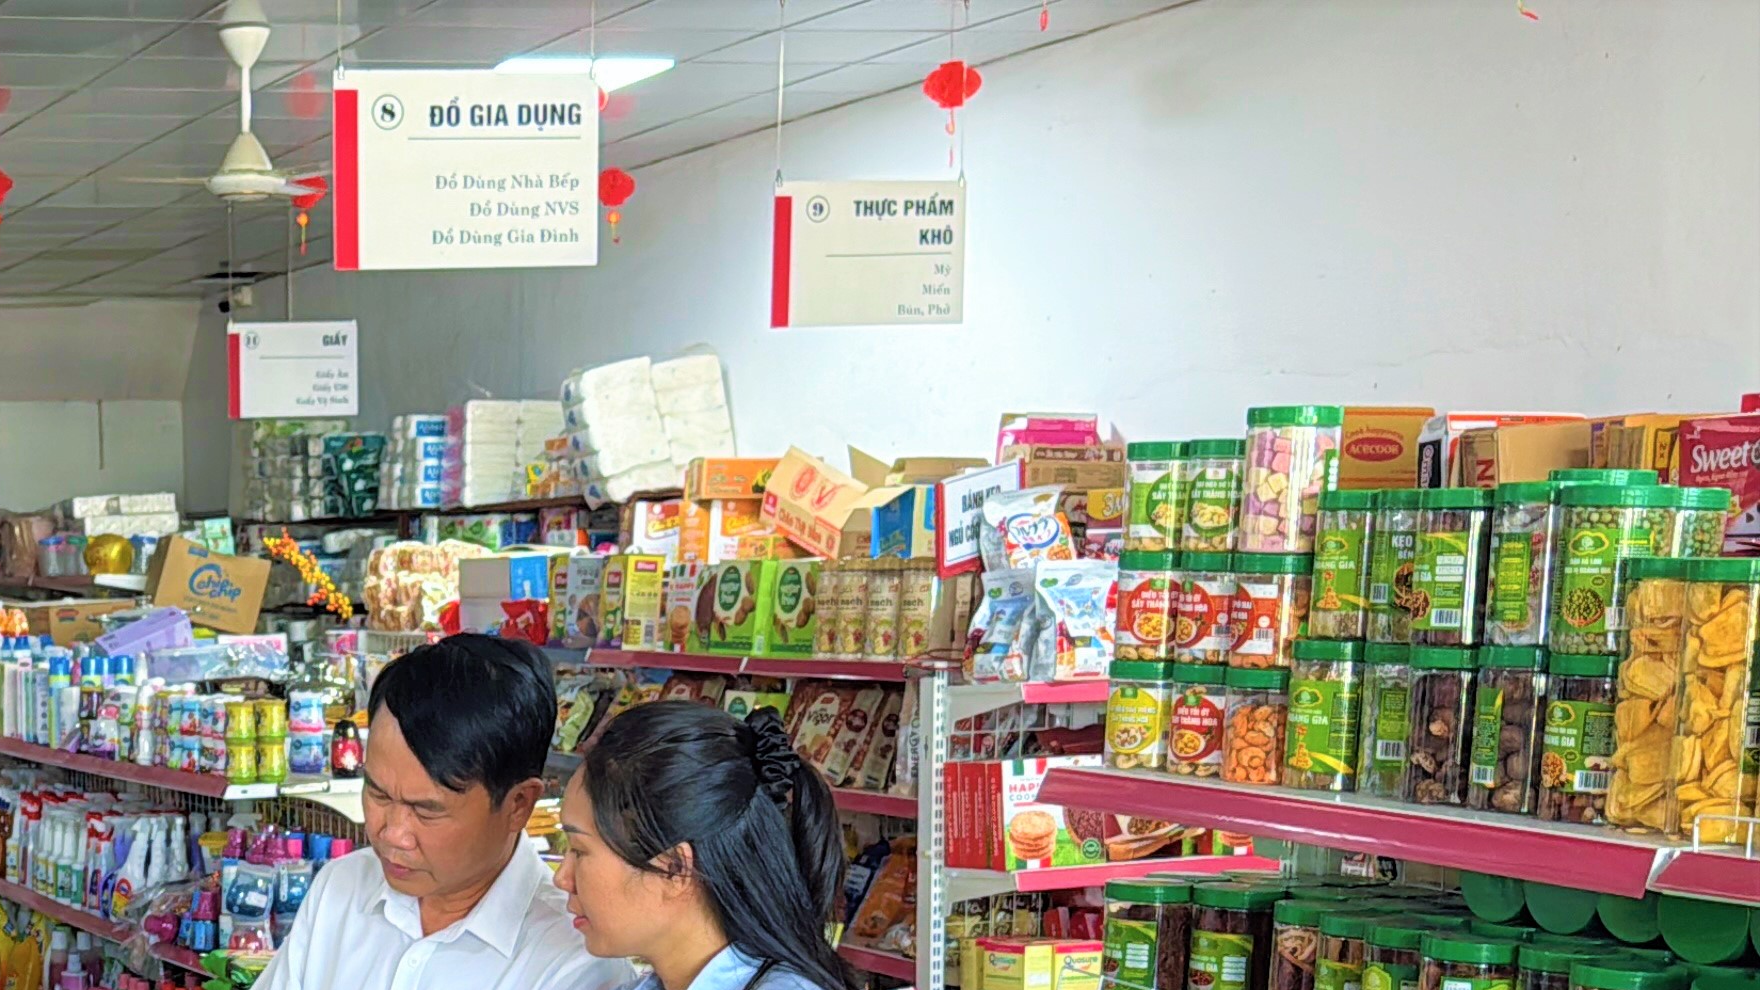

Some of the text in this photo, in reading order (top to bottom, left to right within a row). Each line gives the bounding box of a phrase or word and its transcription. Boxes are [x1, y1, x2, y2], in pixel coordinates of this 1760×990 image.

[380, 102, 396, 123] 8
[429, 96, 582, 131] ĐỒ GIA DỤNG
[435, 171, 580, 191] Đồ Dùng Nhà Bếp
[469, 200, 580, 218] Đồ Dùng NVS
[811, 201, 824, 217] 9
[853, 191, 955, 221] THỰC PHẨM
[431, 228, 579, 246] Đồ Dùng Gia Đình
[919, 225, 954, 246] KHÔ
[927, 303, 951, 316] Phở
[322, 330, 348, 347] GIẤY
[1350, 443, 1401, 456] ACECOOK
[1690, 441, 1749, 475] Sweet
[961, 489, 984, 514] BÁNH
[1391, 534, 1414, 550] KẸO
[1338, 559, 1356, 570] GIA
[1311, 714, 1329, 726] GIA
